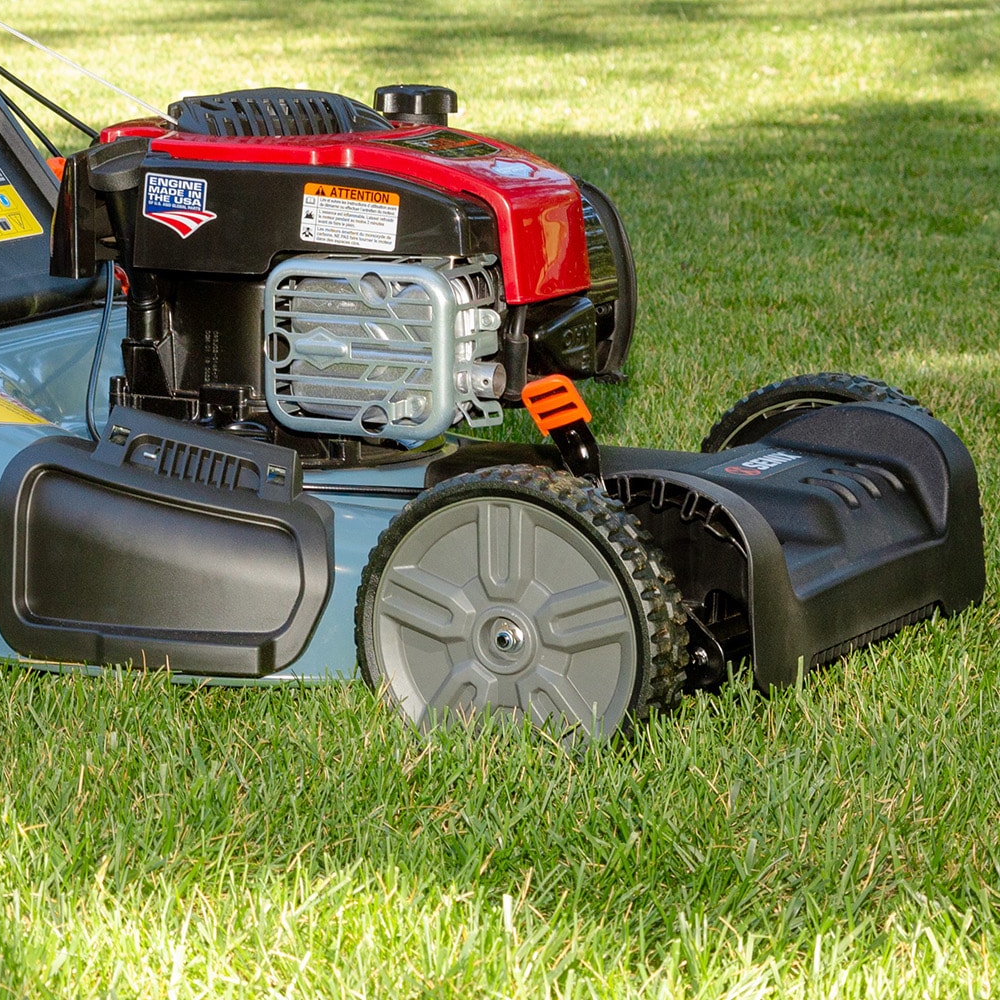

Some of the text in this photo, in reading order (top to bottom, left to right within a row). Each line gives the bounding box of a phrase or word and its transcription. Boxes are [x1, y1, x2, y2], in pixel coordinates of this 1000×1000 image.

[149, 177, 202, 191] ENGINE
[148, 186, 201, 199] MADE IN
[148, 193, 202, 206] THE USA
[330, 187, 390, 203] ATTENTION
[742, 451, 802, 471] SENIX
